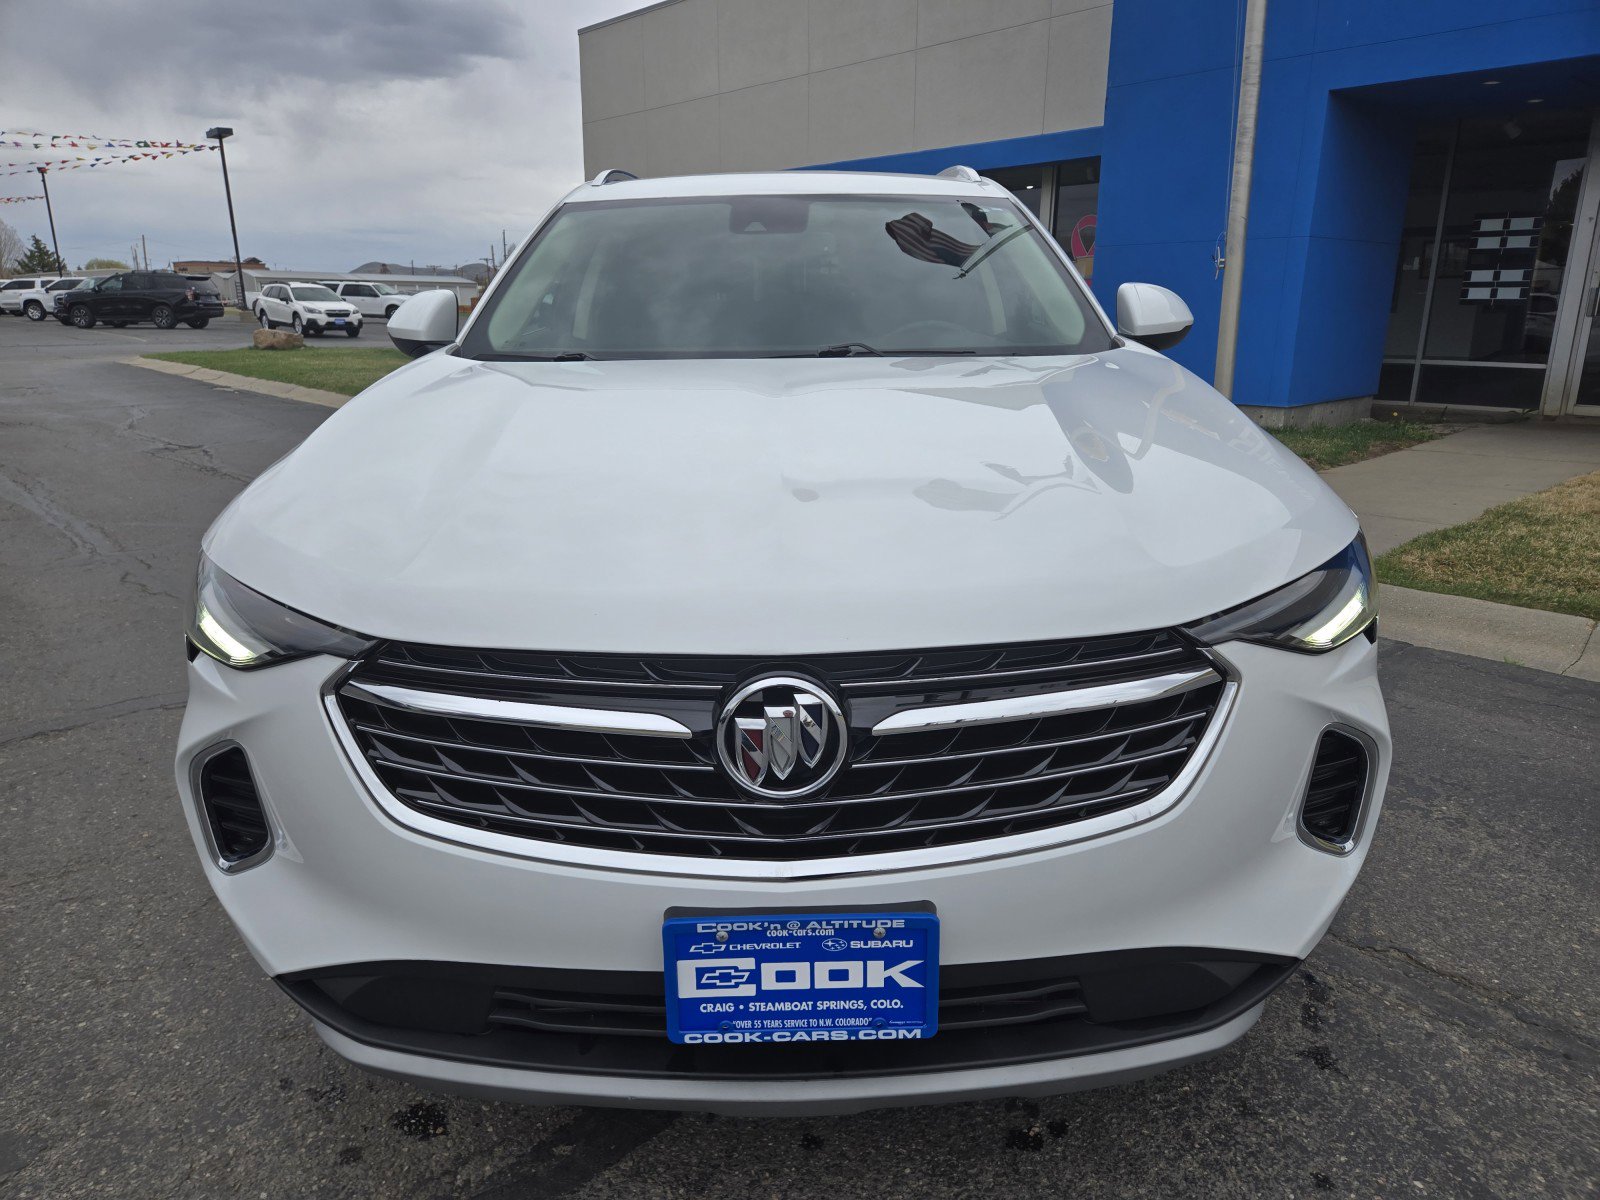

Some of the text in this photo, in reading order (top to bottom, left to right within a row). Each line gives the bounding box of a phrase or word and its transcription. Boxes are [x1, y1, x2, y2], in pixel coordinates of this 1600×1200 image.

[806, 919, 906, 929] ALTITUDE
[729, 941, 801, 951] CHEVROLET
[850, 939, 914, 949] SUBARU
[677, 957, 925, 999] COOK
[699, 998, 904, 1013] CRAIG STEAMBOAT SPRINGS, COLO.
[753, 1020, 762, 1029] 55
[763, 1019, 783, 1028] YEARS
[784, 1019, 808, 1028] SERVICE
[809, 1018, 818, 1027] TO
[819, 1018, 834, 1027] N.W.
[684, 1028, 922, 1044] COOK-CARS.COM
